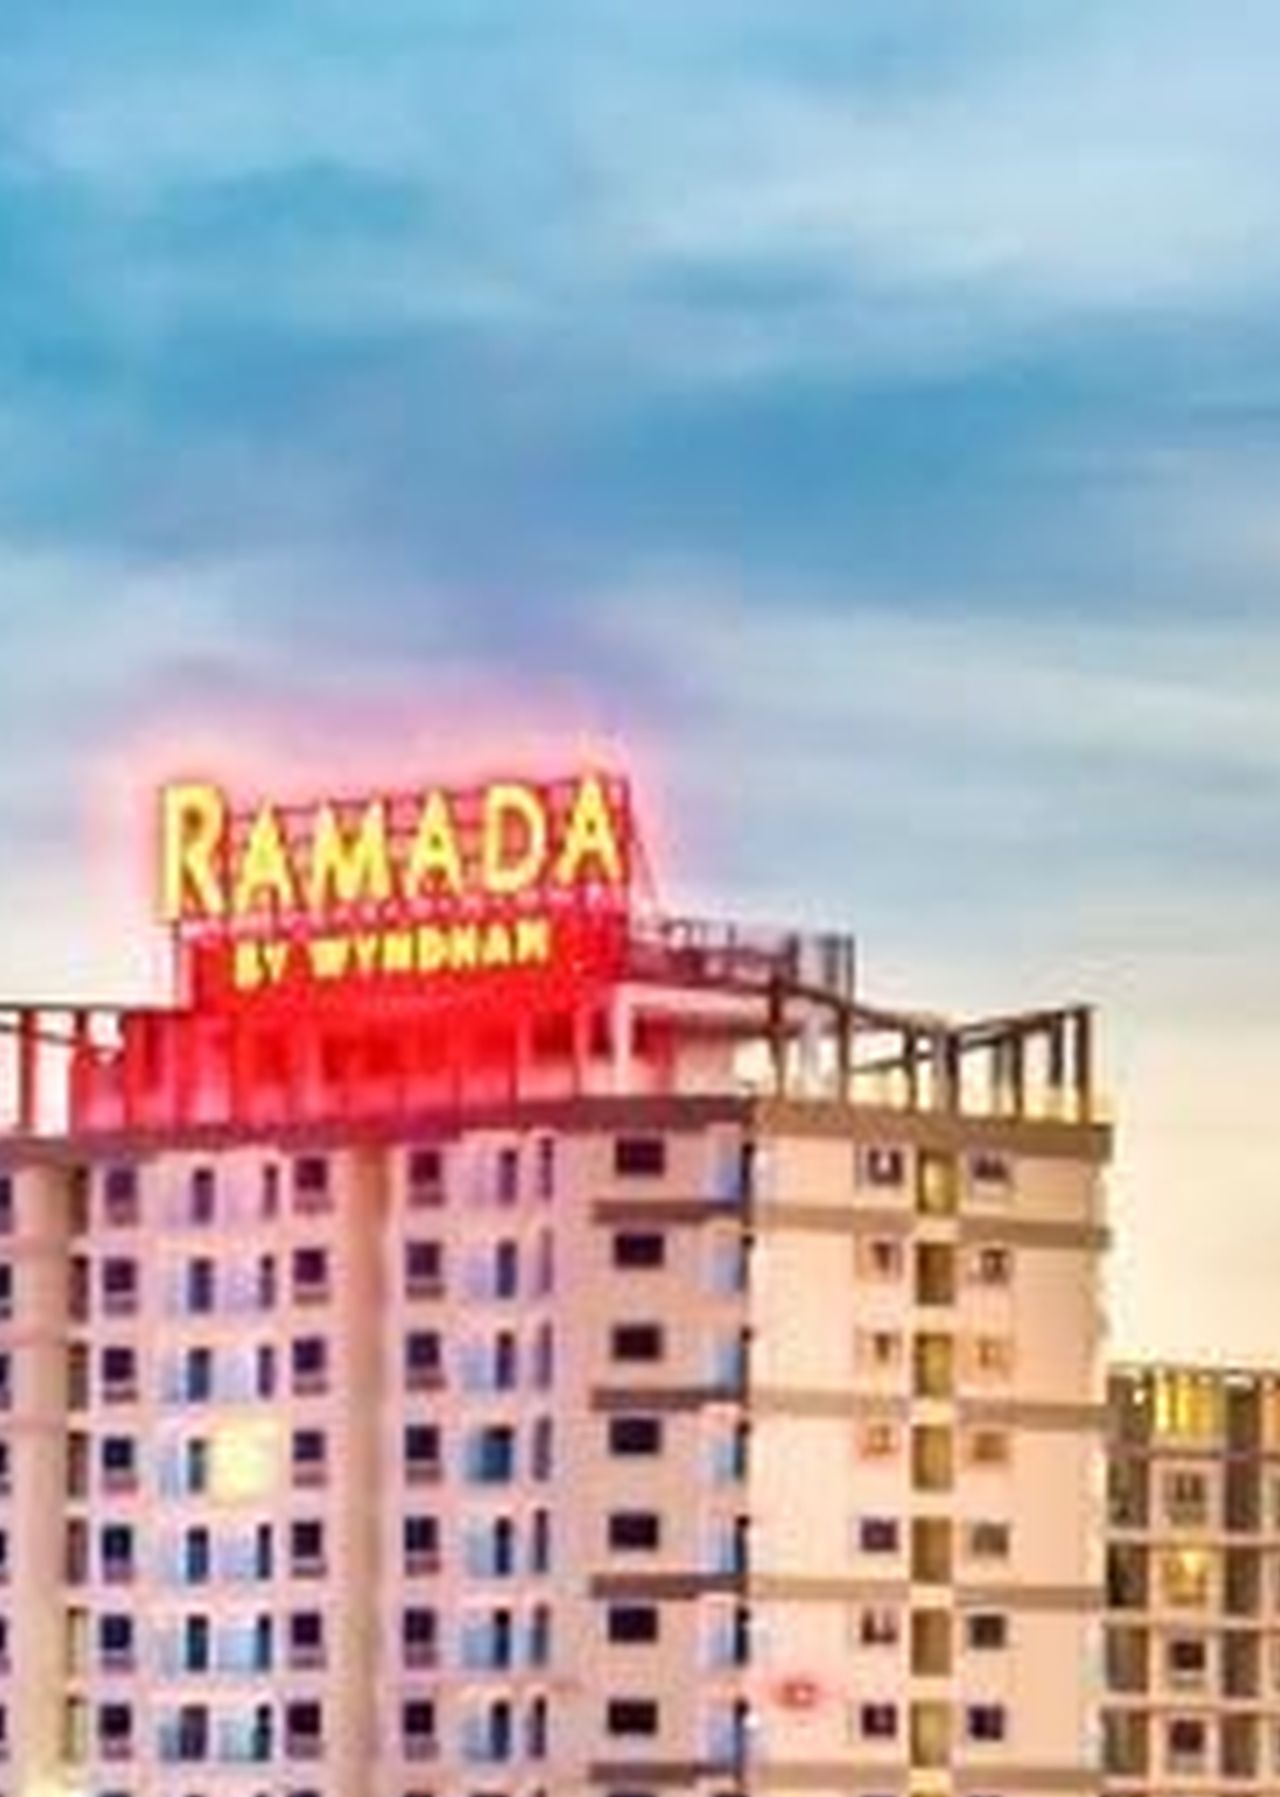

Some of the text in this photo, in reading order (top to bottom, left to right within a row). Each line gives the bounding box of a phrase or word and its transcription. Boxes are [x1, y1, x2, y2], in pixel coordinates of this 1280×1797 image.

[163, 772, 619, 919] RAMADA
[234, 917, 551, 990] BY WYNDHAM
